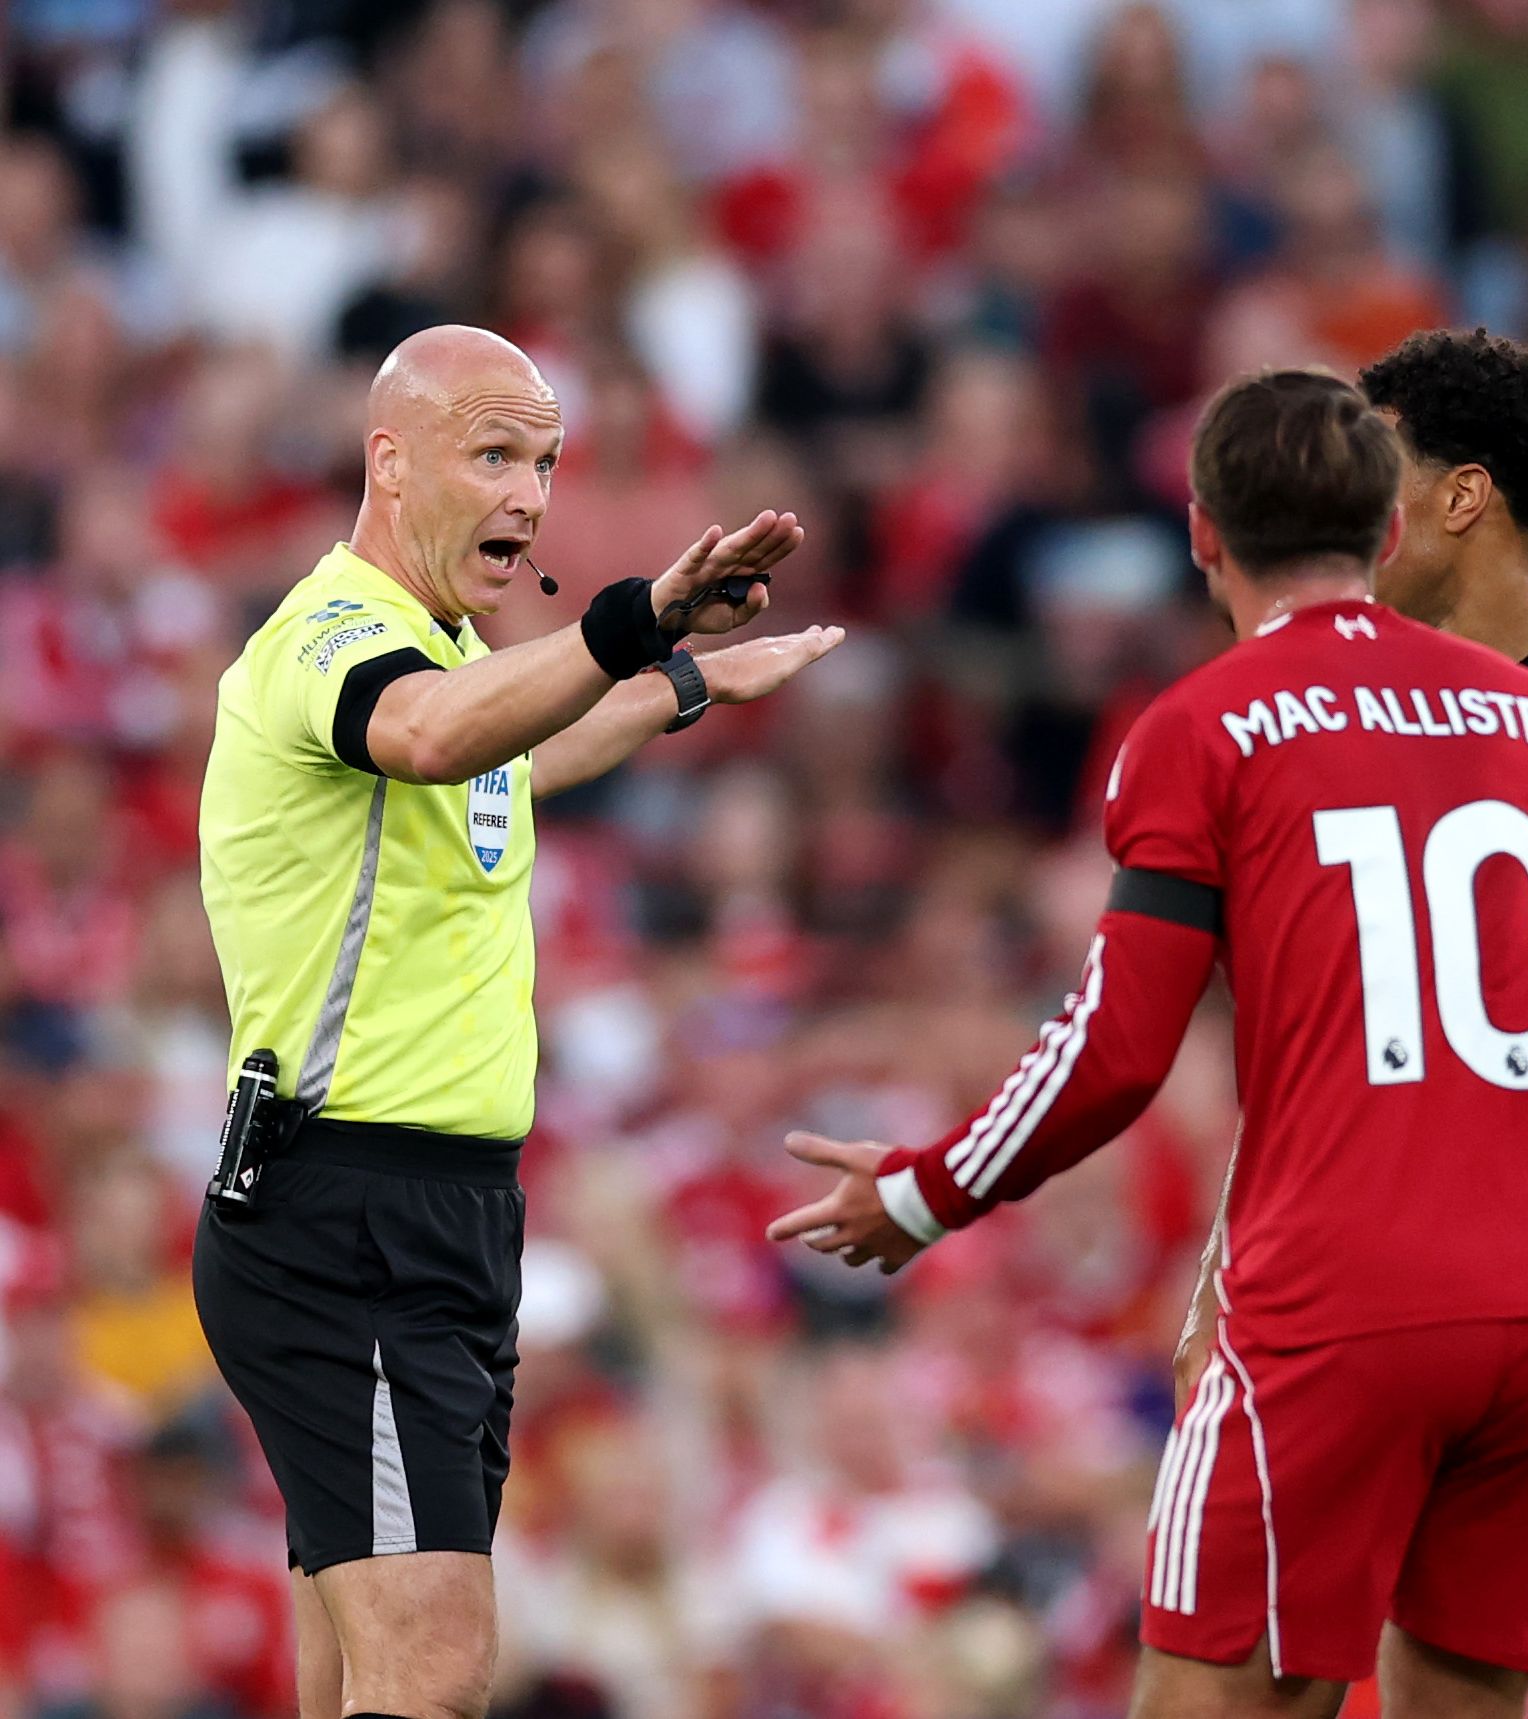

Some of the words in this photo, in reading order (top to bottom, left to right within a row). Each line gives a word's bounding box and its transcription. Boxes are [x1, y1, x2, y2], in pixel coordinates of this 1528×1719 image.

[1221, 686, 1346, 756] MAC
[475, 768, 508, 796] FIFA
[473, 811, 508, 829] REFEREE
[481, 850, 498, 863] 2025
